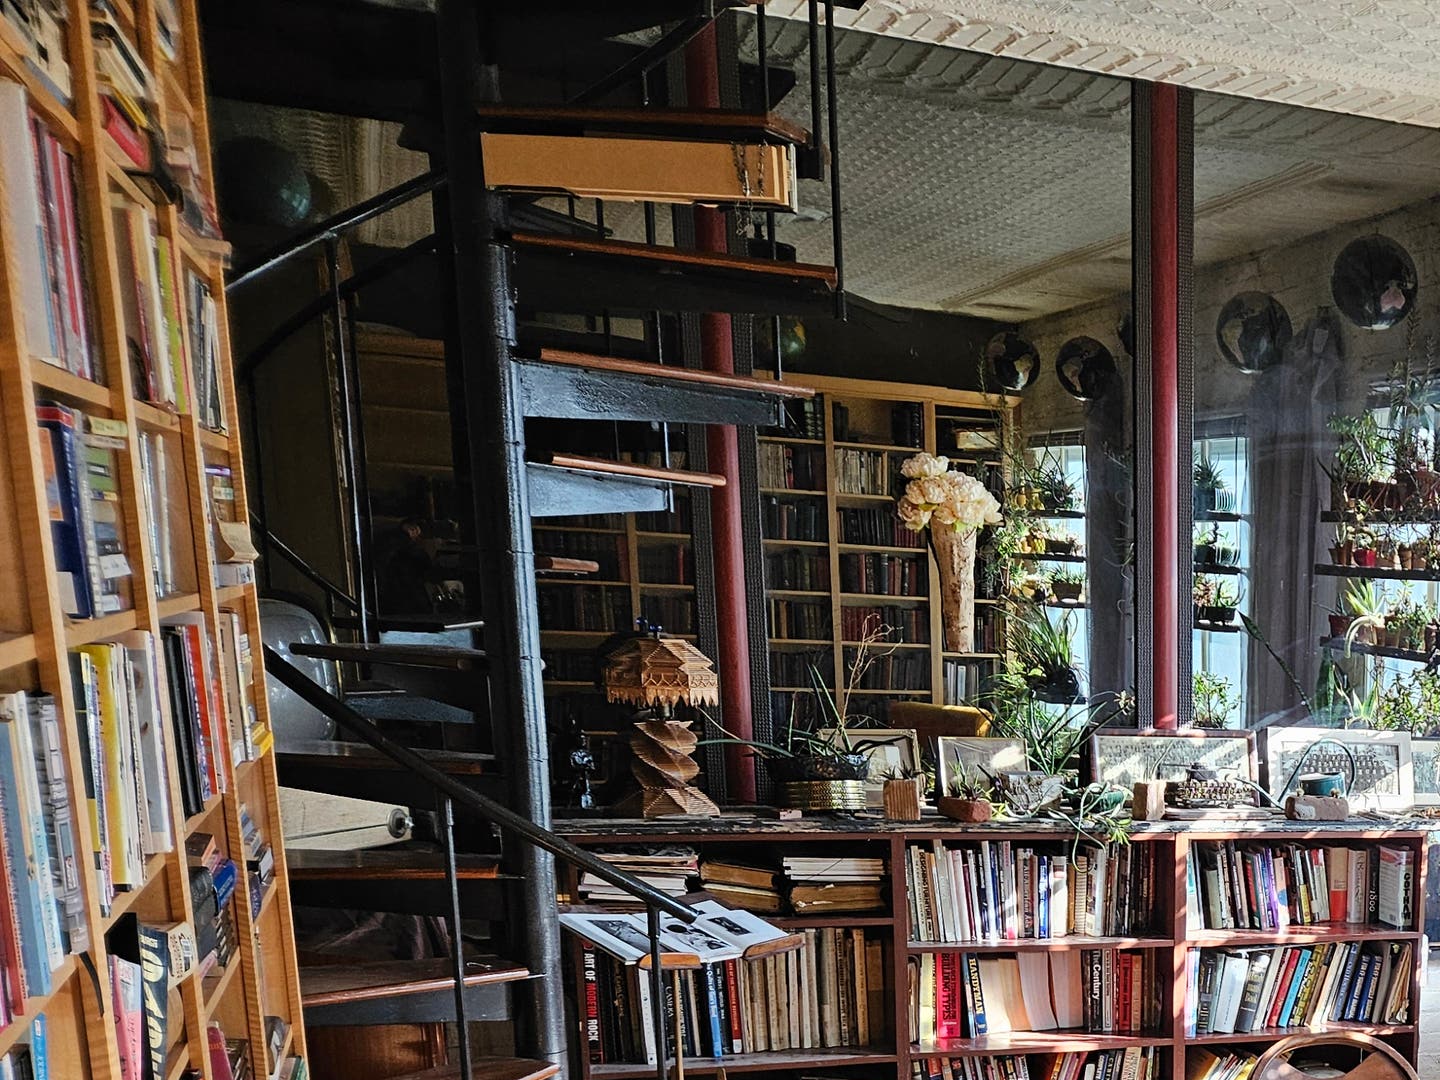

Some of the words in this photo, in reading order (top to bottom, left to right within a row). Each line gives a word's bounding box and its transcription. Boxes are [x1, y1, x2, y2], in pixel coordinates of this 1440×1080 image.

[919, 851, 928, 886] DESIGNING
[1369, 890, 1377, 912] 1800
[1403, 872, 1411, 919] GOTHAM
[584, 953, 594, 968] ART
[585, 970, 595, 981] OF
[942, 953, 950, 992] BUILDING
[586, 982, 597, 1017] MODERN
[665, 986, 673, 1017] CAMERA
[969, 958, 984, 1014] HANDYMAN
[943, 993, 951, 1020] TYPES
[588, 1019, 598, 1041] ROCK
